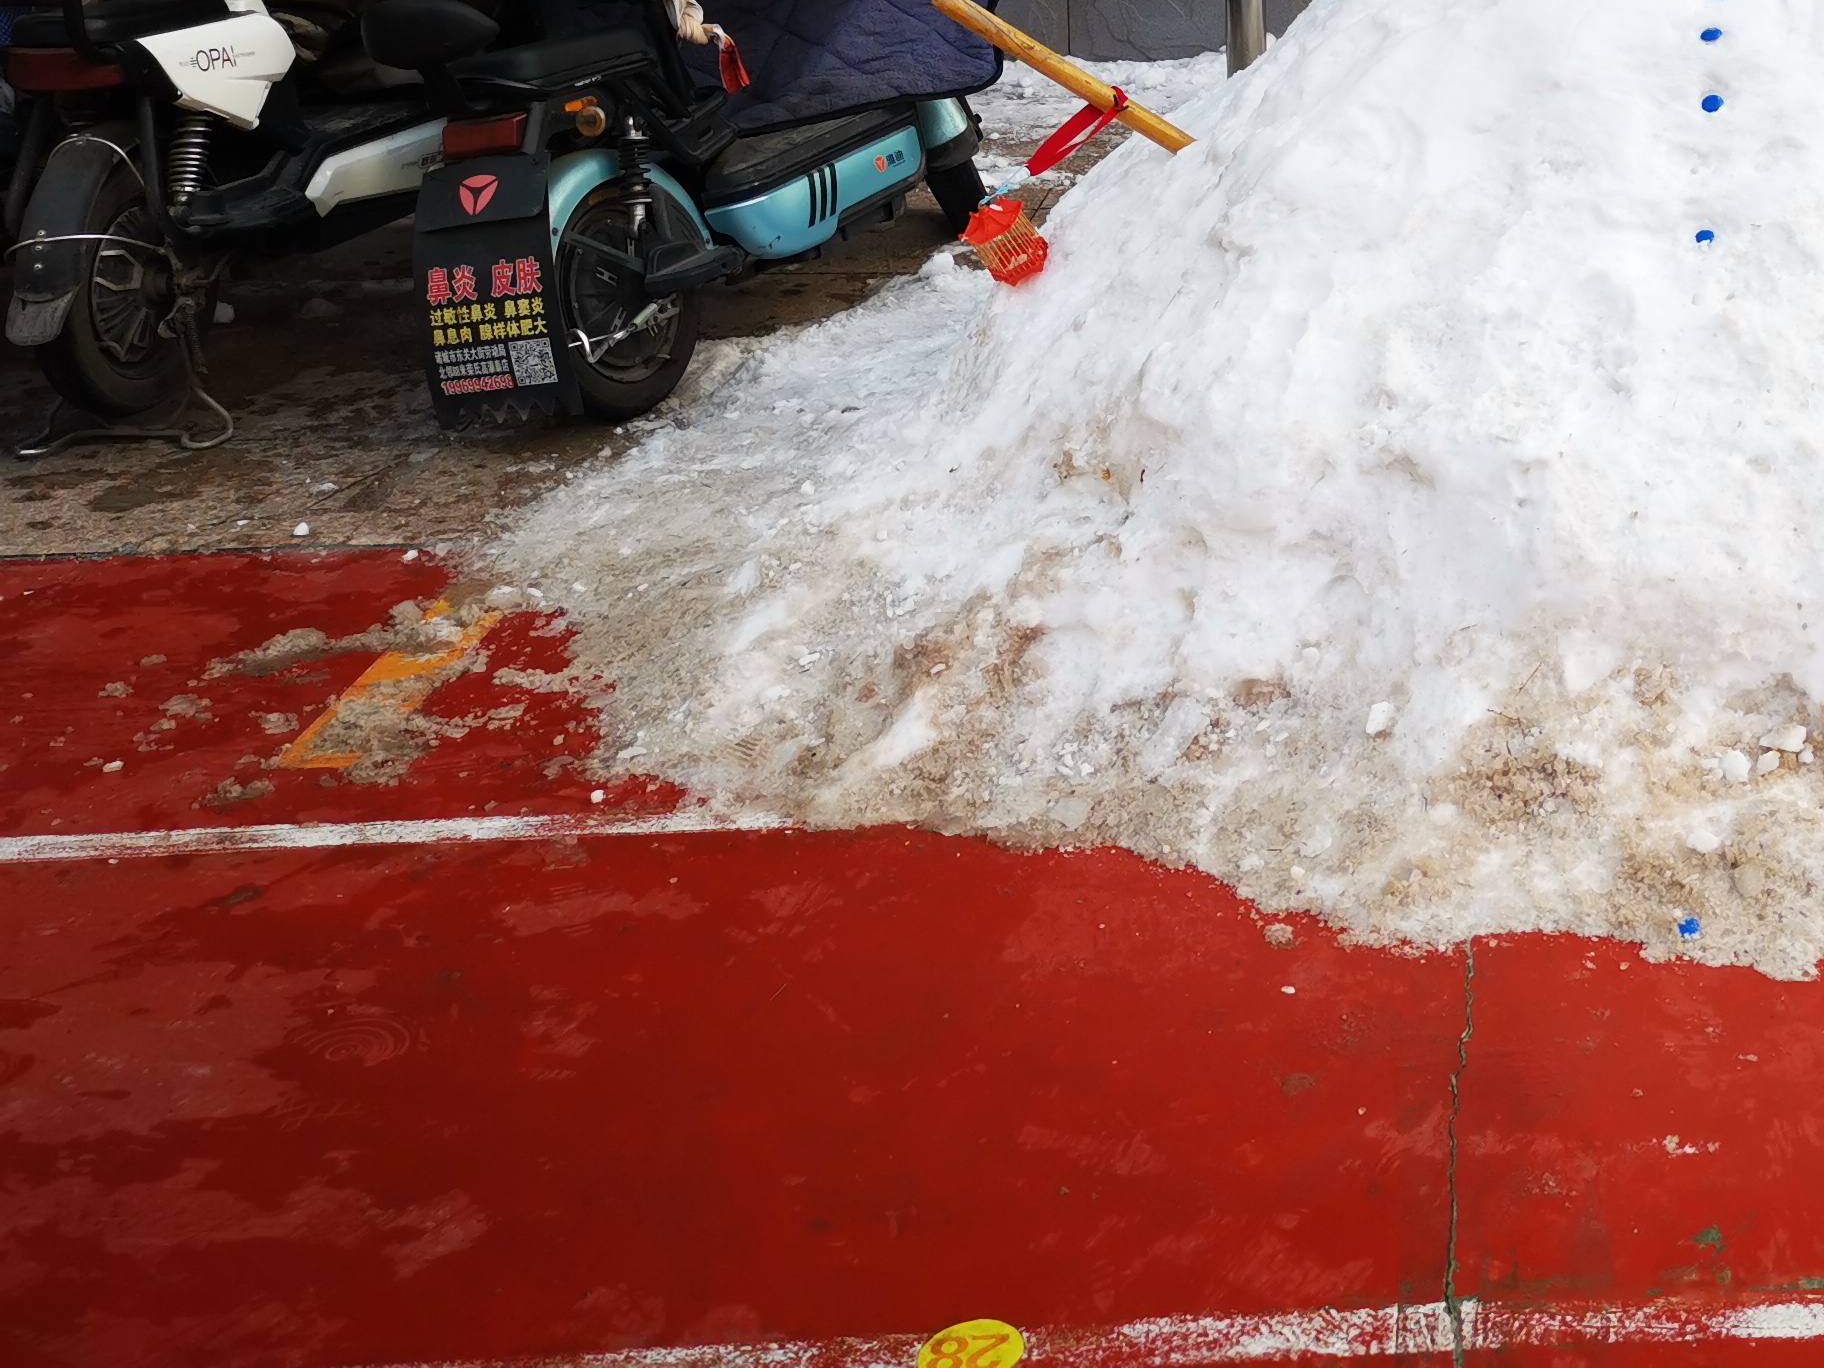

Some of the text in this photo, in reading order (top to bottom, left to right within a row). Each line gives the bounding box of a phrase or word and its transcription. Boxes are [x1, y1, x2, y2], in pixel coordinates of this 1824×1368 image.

[427, 256, 543, 306] 鼻炎 皮肤
[430, 296, 545, 326] 过敏性鼻炎 鼻窦炎
[433, 317, 548, 346] 鼻息肉 腺样体肥大
[441, 374, 514, 395] 19969942698
